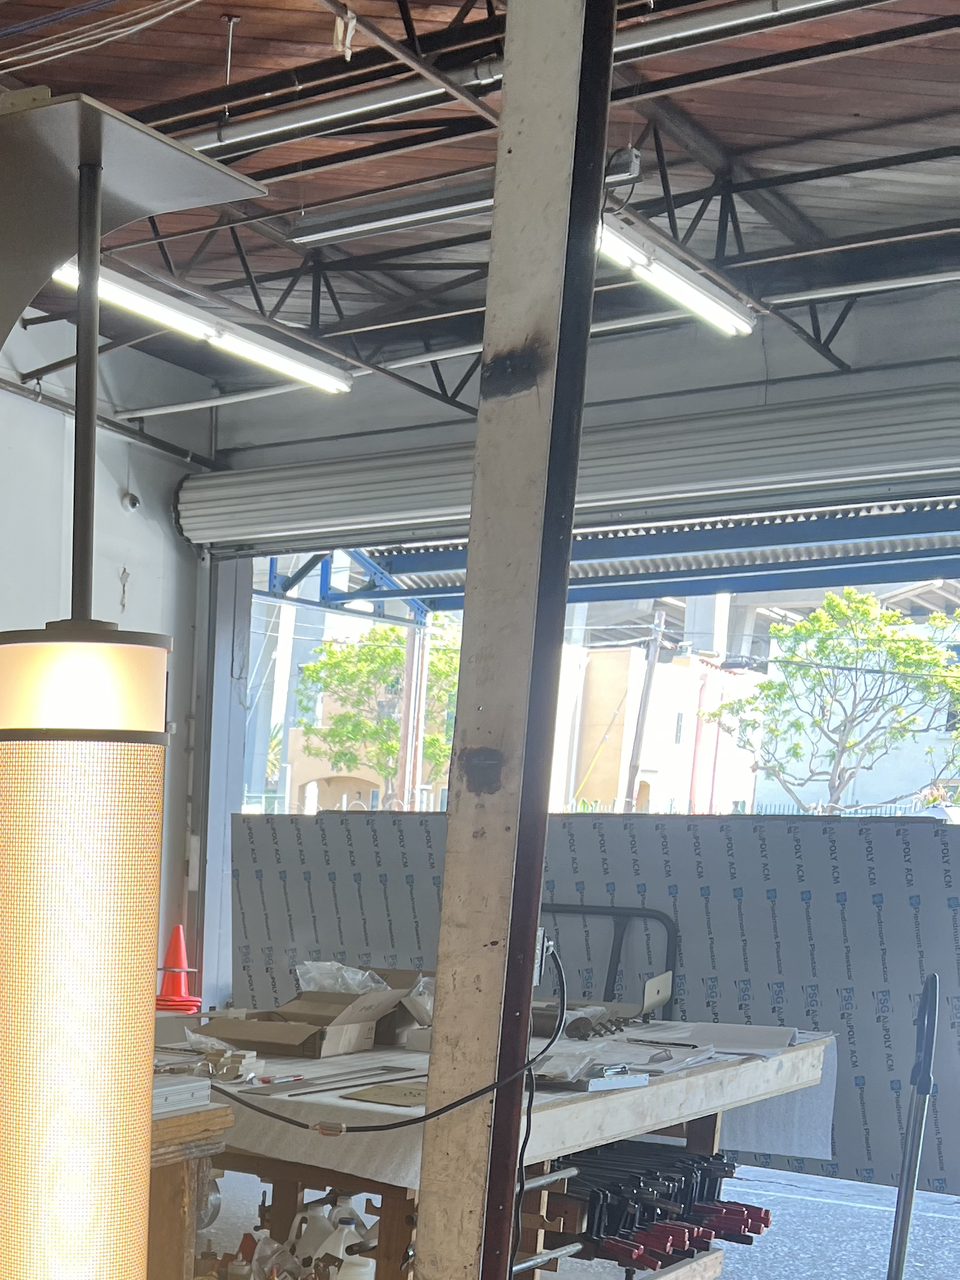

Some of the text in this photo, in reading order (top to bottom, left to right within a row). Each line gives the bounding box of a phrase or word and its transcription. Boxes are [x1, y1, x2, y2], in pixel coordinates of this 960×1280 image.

[659, 823, 669, 856] AluPOLY
[691, 824, 704, 879] AluPOLY ACM
[724, 824, 735, 858] AluPOLY
[571, 857, 579, 874] ACM
[758, 825, 770, 882] AluPOLY ACM
[792, 826, 805, 883] AluPOLY ACM
[828, 827, 840, 884] AluPOLY ACM
[864, 827, 876, 886] AluPOLY ACM
[902, 828, 914, 887] AluPOLY ACM
[940, 829, 952, 889] AluPOLY ACM
[632, 858, 640, 876] ACM
[704, 897, 712, 936] Piedmont
[737, 898, 745, 938] Piedmont
[771, 900, 779, 940] Piedmont
[876, 905, 884, 946] Piedmont
[913, 907, 922, 949] Piedmont
[805, 902, 817, 978] Piedmont Plastics
[840, 904, 852, 980] Piedmont Plastics
[362, 953, 371, 967] PS
[389, 954, 397, 969] PS
[415, 956, 423, 971] PS
[584, 968, 593, 990] PSG
[676, 974, 685, 996] PSG
[708, 976, 718, 999] PSG
[741, 979, 750, 1001] PSG
[774, 982, 784, 1004] PSG
[808, 984, 818, 1007] PSG
[843, 987, 854, 1010] PSG
[879, 990, 889, 1013] PSG
[679, 998, 687, 1022] AluPO
[710, 1000, 719, 1023] AluPO
[810, 1009, 820, 1032] AluPO
[845, 1012, 859, 1068] AluPOLY ACM
[881, 1016, 894, 1072] AluPOLY ACM
[895, 1091, 904, 1131] Piedmont
[858, 1086, 872, 1161] Piedmont Plastics
[932, 1094, 944, 1171] Piedmont Plastics
[729, 1151, 738, 1162] PS
[762, 1154, 771, 1167] PS
[794, 1158, 804, 1172] PS
[827, 1163, 838, 1177] PS
[862, 1168, 874, 1182] PS
[934, 1179, 946, 1192] PS
